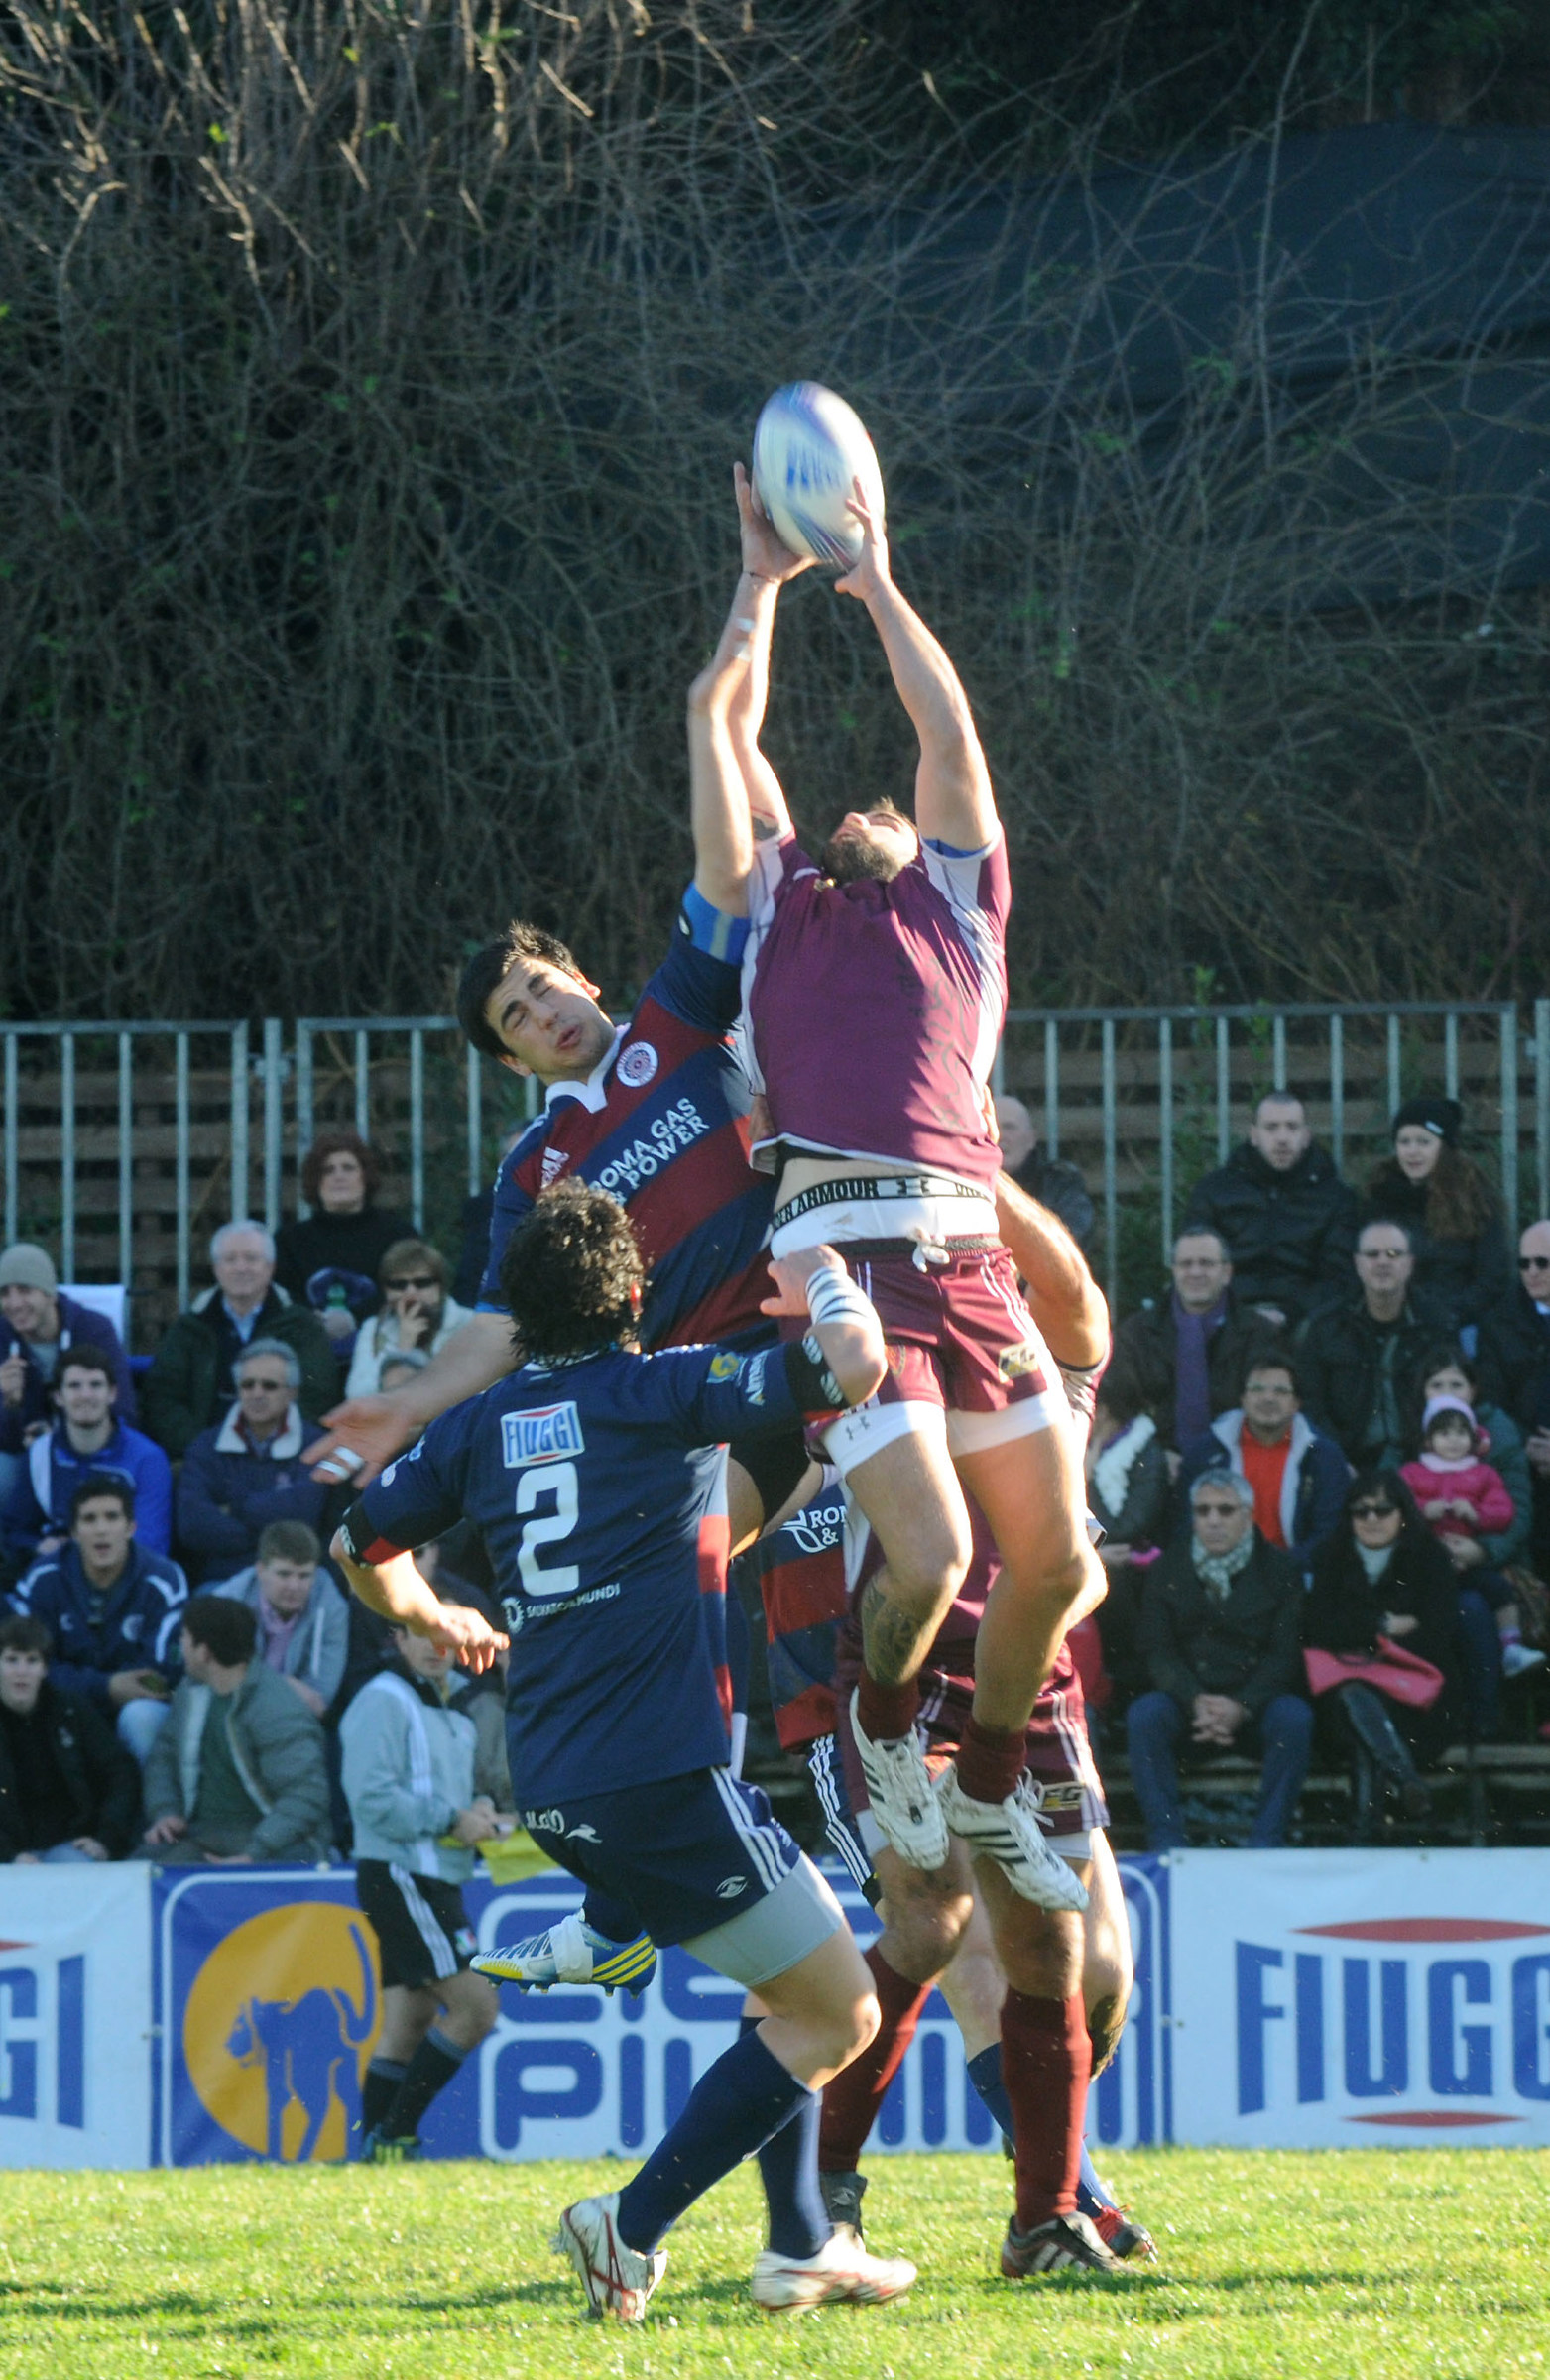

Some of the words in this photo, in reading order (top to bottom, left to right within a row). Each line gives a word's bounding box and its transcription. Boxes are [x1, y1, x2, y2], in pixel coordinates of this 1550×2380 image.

[651, 1098, 697, 1139] GAS
[624, 1115, 710, 1190] POWER
[795, 1179, 877, 1213] ARMOUR
[505, 1407, 579, 1464] FIUGGI
[515, 1461, 580, 1598] 2
[821, 1527, 839, 1546] &
